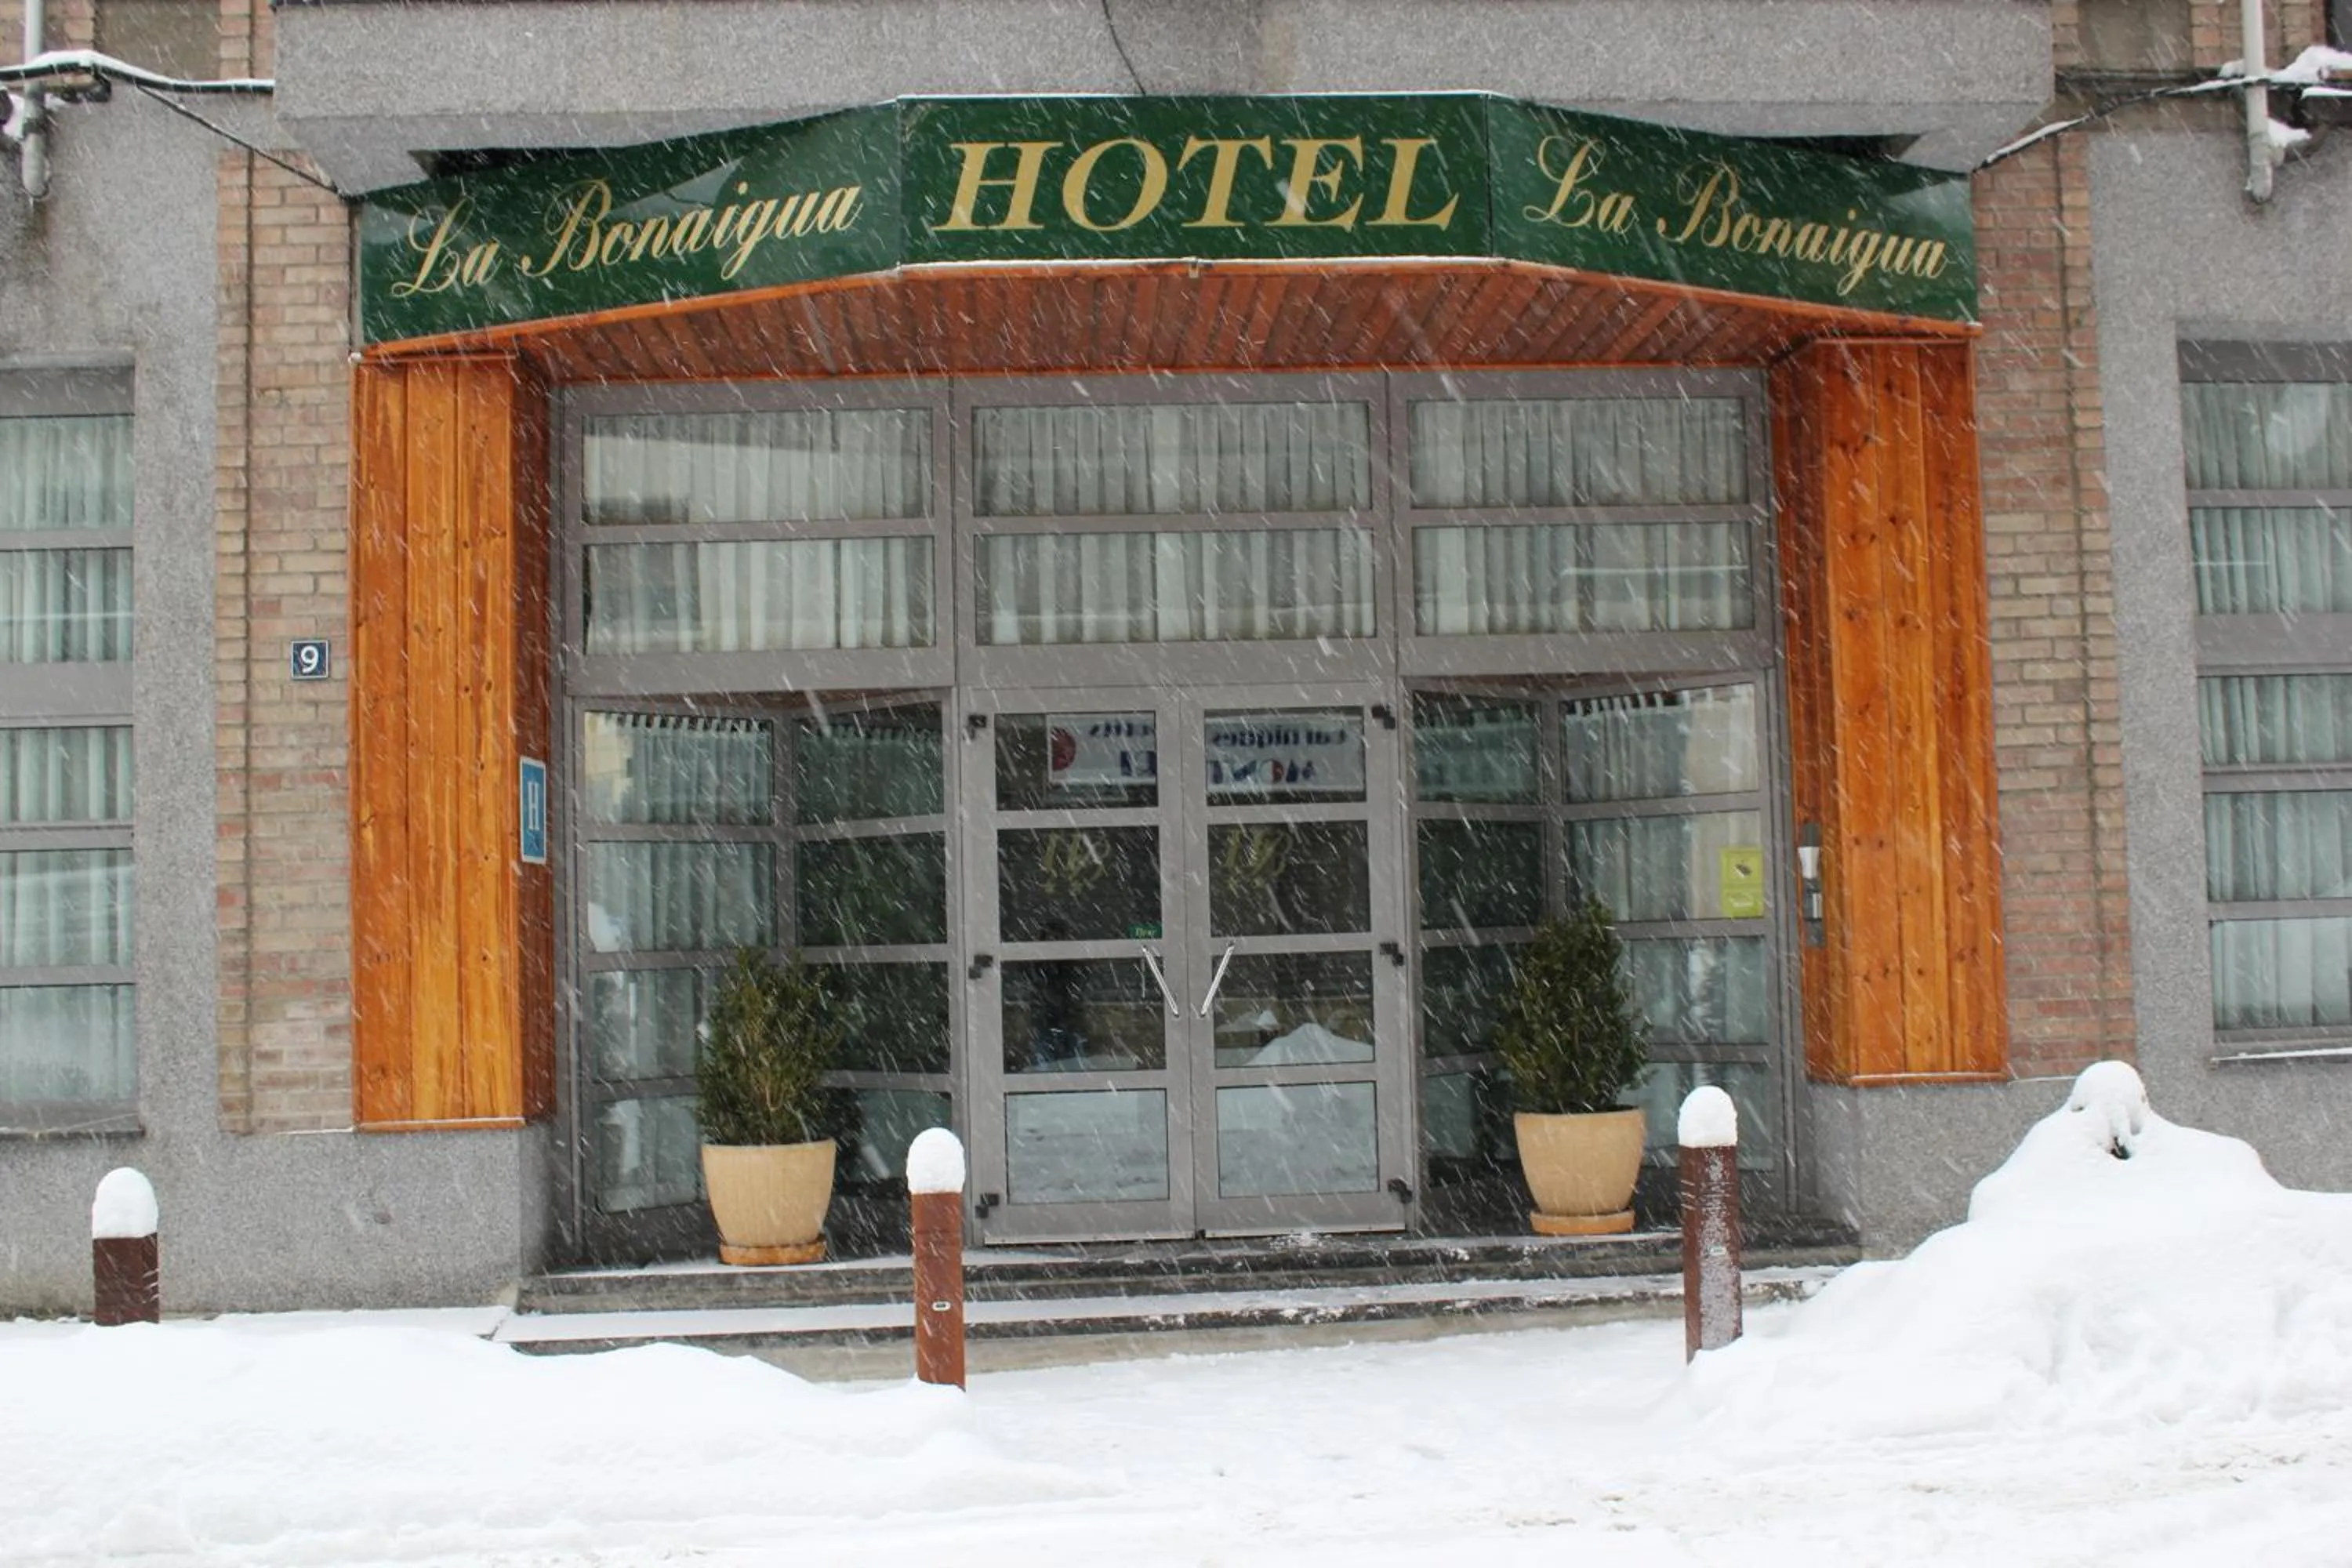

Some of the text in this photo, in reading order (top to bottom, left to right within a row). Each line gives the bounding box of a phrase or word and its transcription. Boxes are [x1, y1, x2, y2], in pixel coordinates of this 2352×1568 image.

[931, 134, 1461, 233] HOTEL
[1523, 134, 1955, 297] La Bonaigua
[391, 179, 862, 299] La Bonaigua
[300, 644, 319, 674] 9
[527, 780, 540, 832] H
